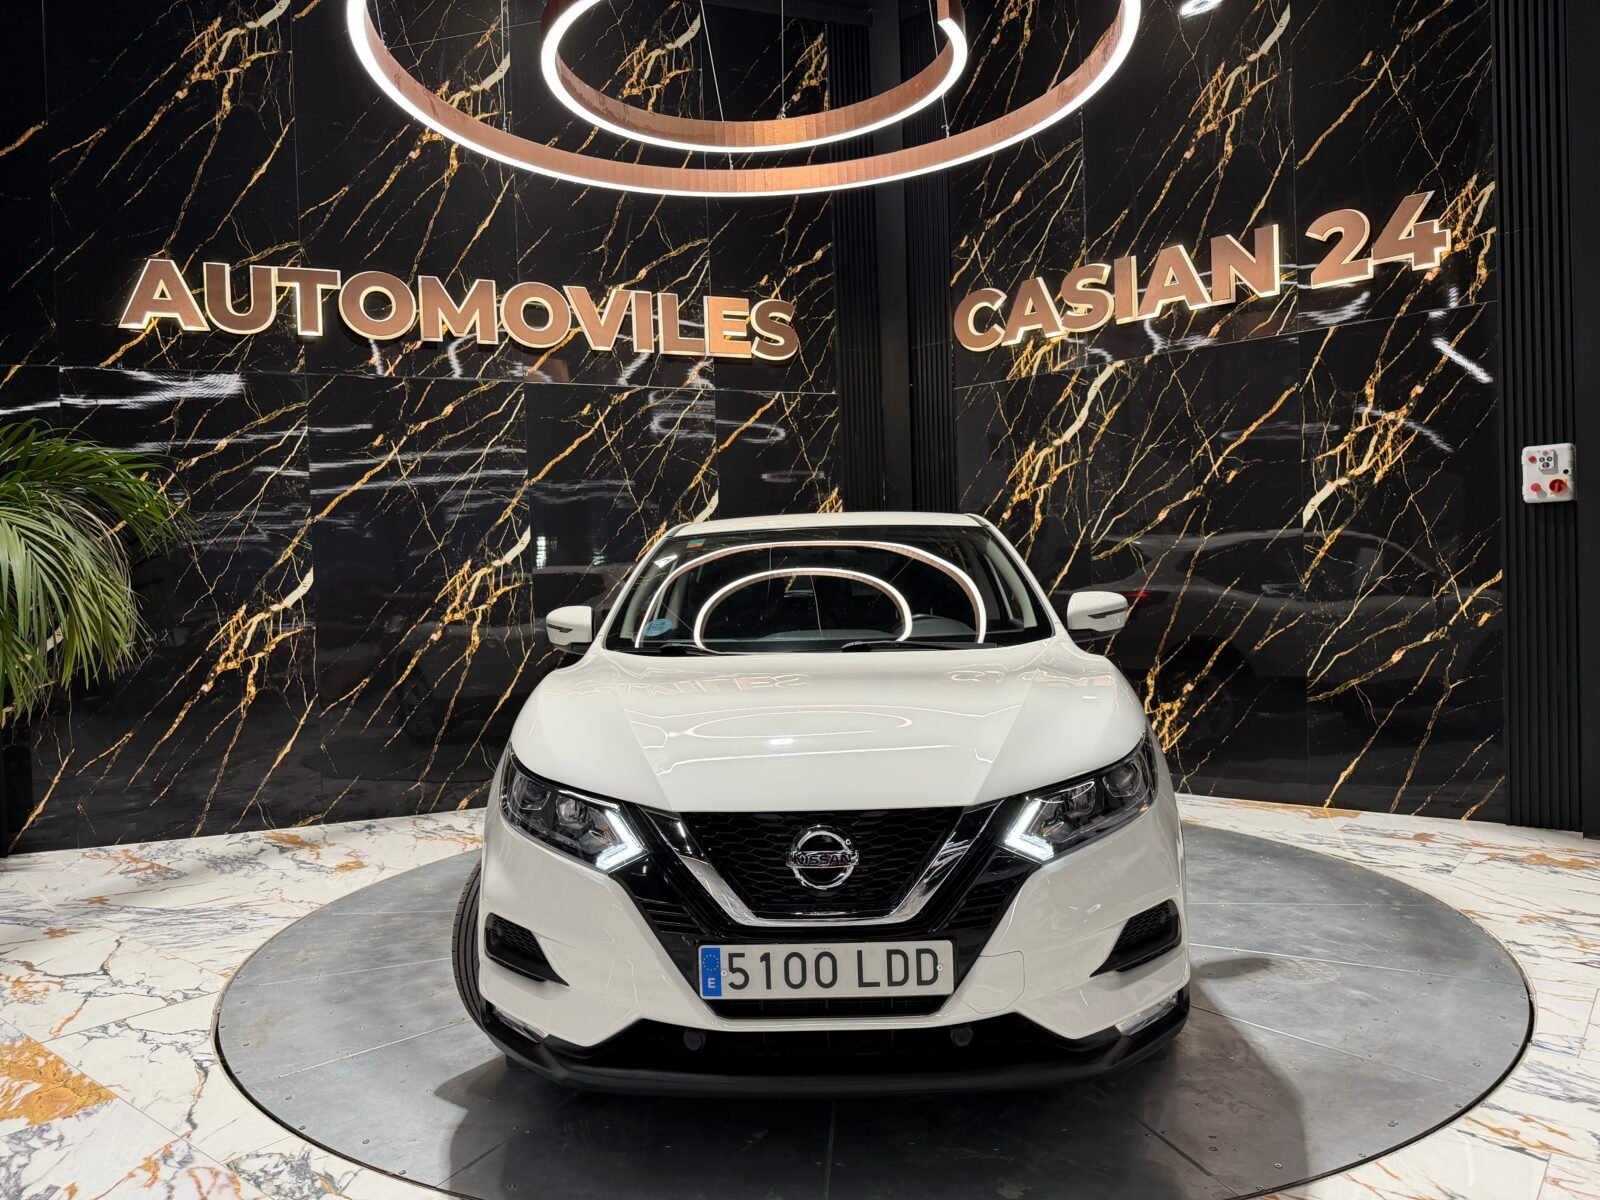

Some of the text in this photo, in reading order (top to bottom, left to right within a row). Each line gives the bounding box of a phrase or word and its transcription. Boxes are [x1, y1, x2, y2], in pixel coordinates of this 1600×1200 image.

[954, 190, 1451, 352] CASIAN 24
[119, 258, 798, 361] AUTOMOVILES
[793, 852, 851, 865] NISSAN
[707, 977, 716, 989] E
[728, 948, 938, 990] 5100 LDD
